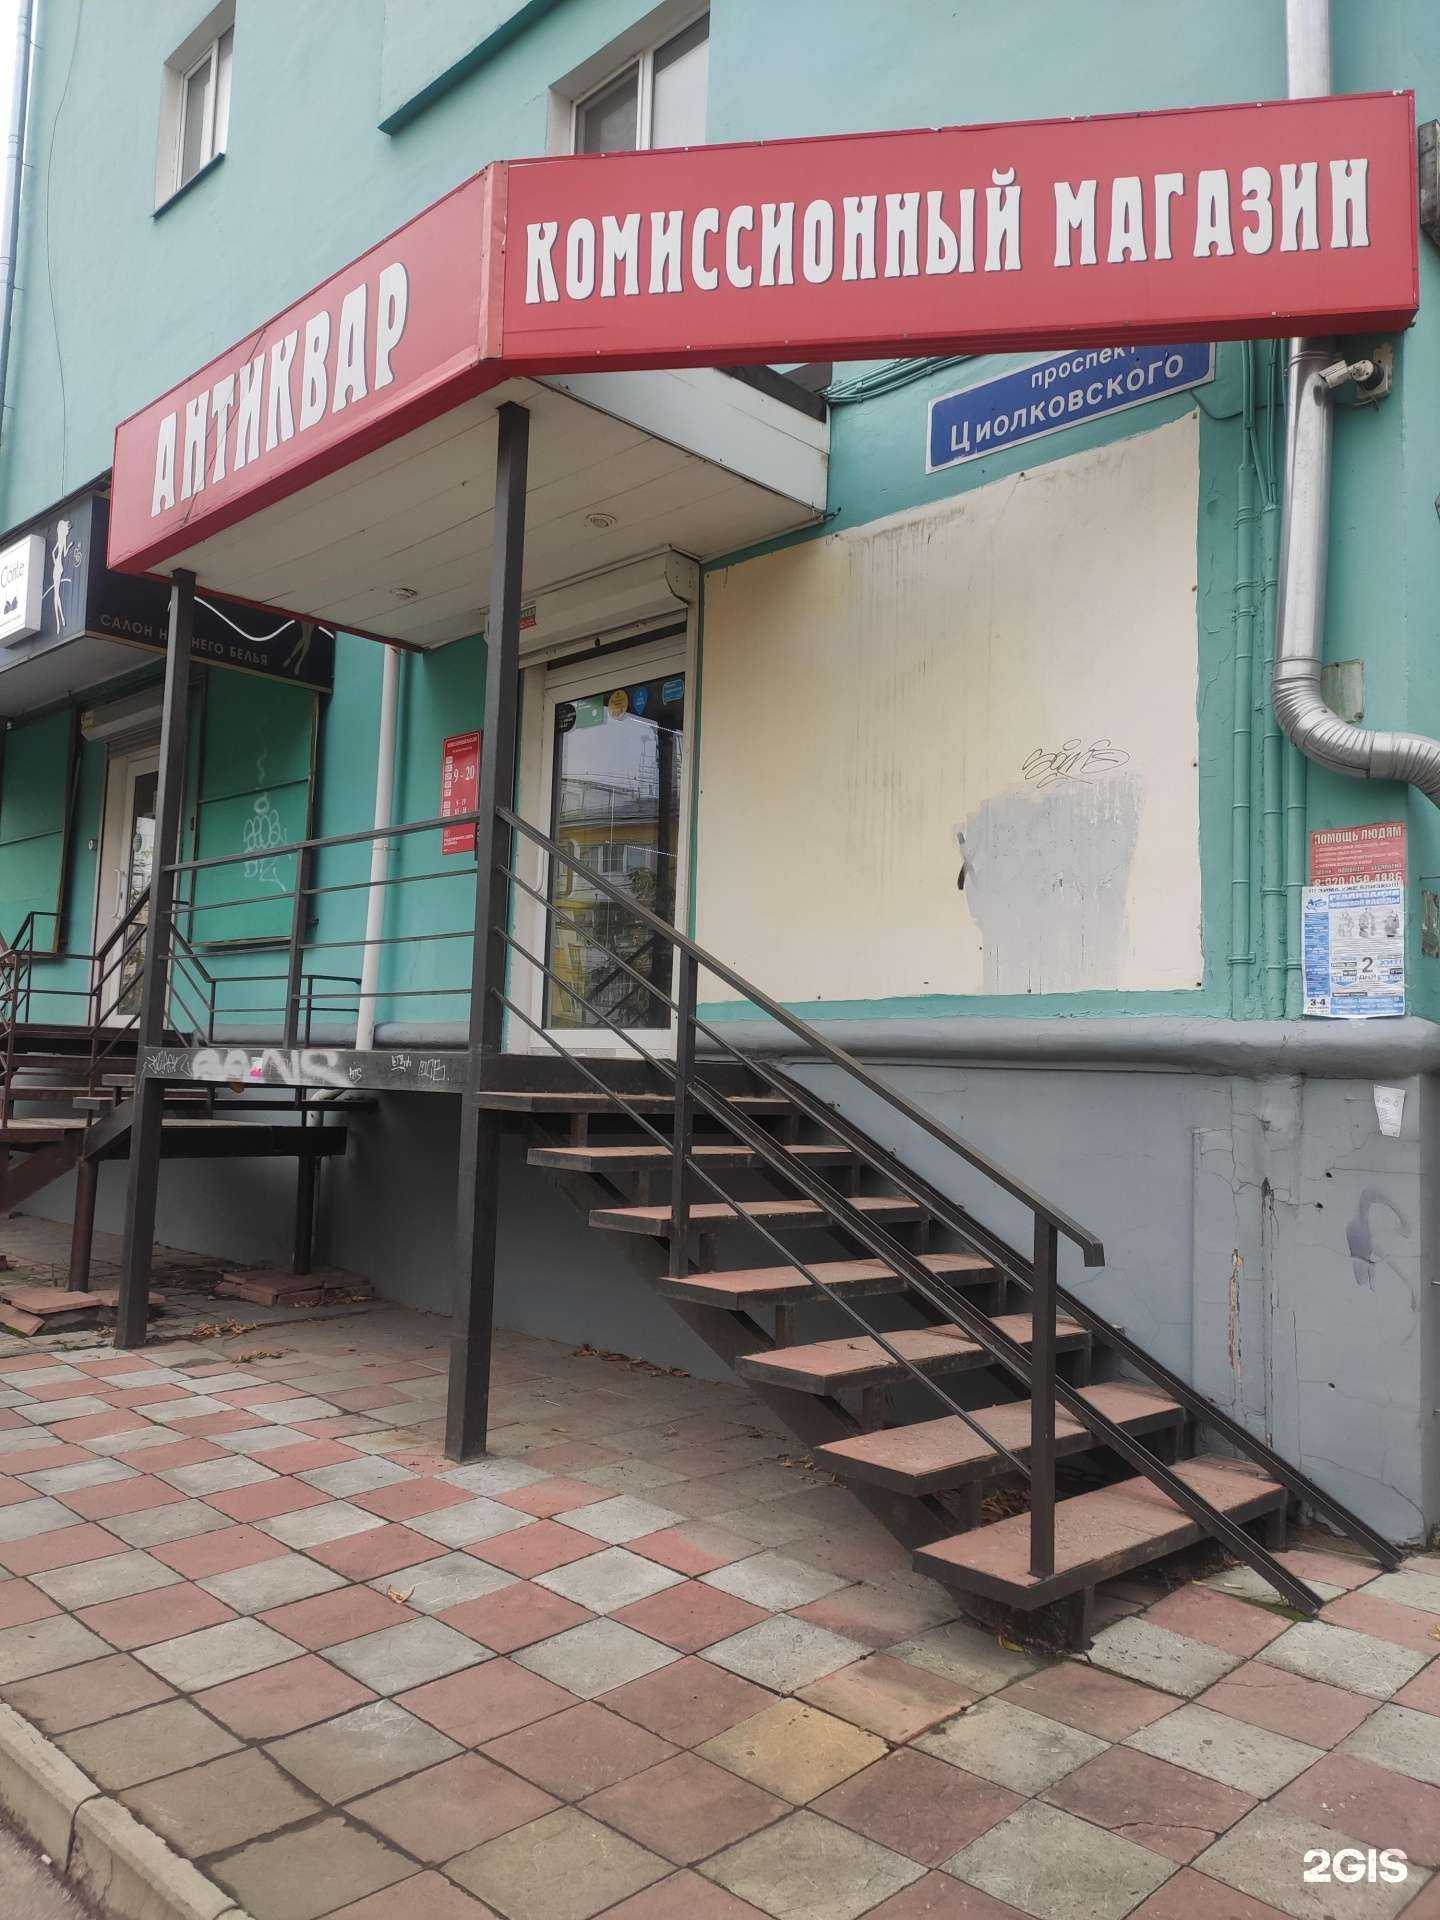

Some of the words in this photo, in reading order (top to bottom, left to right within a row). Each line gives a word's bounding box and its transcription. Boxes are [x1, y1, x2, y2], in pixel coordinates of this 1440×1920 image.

[525, 167, 1022, 304] КОМИССИОННЫЙ
[1053, 158, 1369, 268] МАГАЗИН
[150, 262, 408, 518] АНТИКВАР
[950, 354, 1184, 452] Циолковского
[1031, 346, 1135, 389] проспек
[100, 614, 153, 637] САЛОН
[159, 628, 224, 655] ННЕГО
[230, 646, 269, 666] БЕЛЬЯ
[1361, 826, 1401, 841] ЛЮДЯМ
